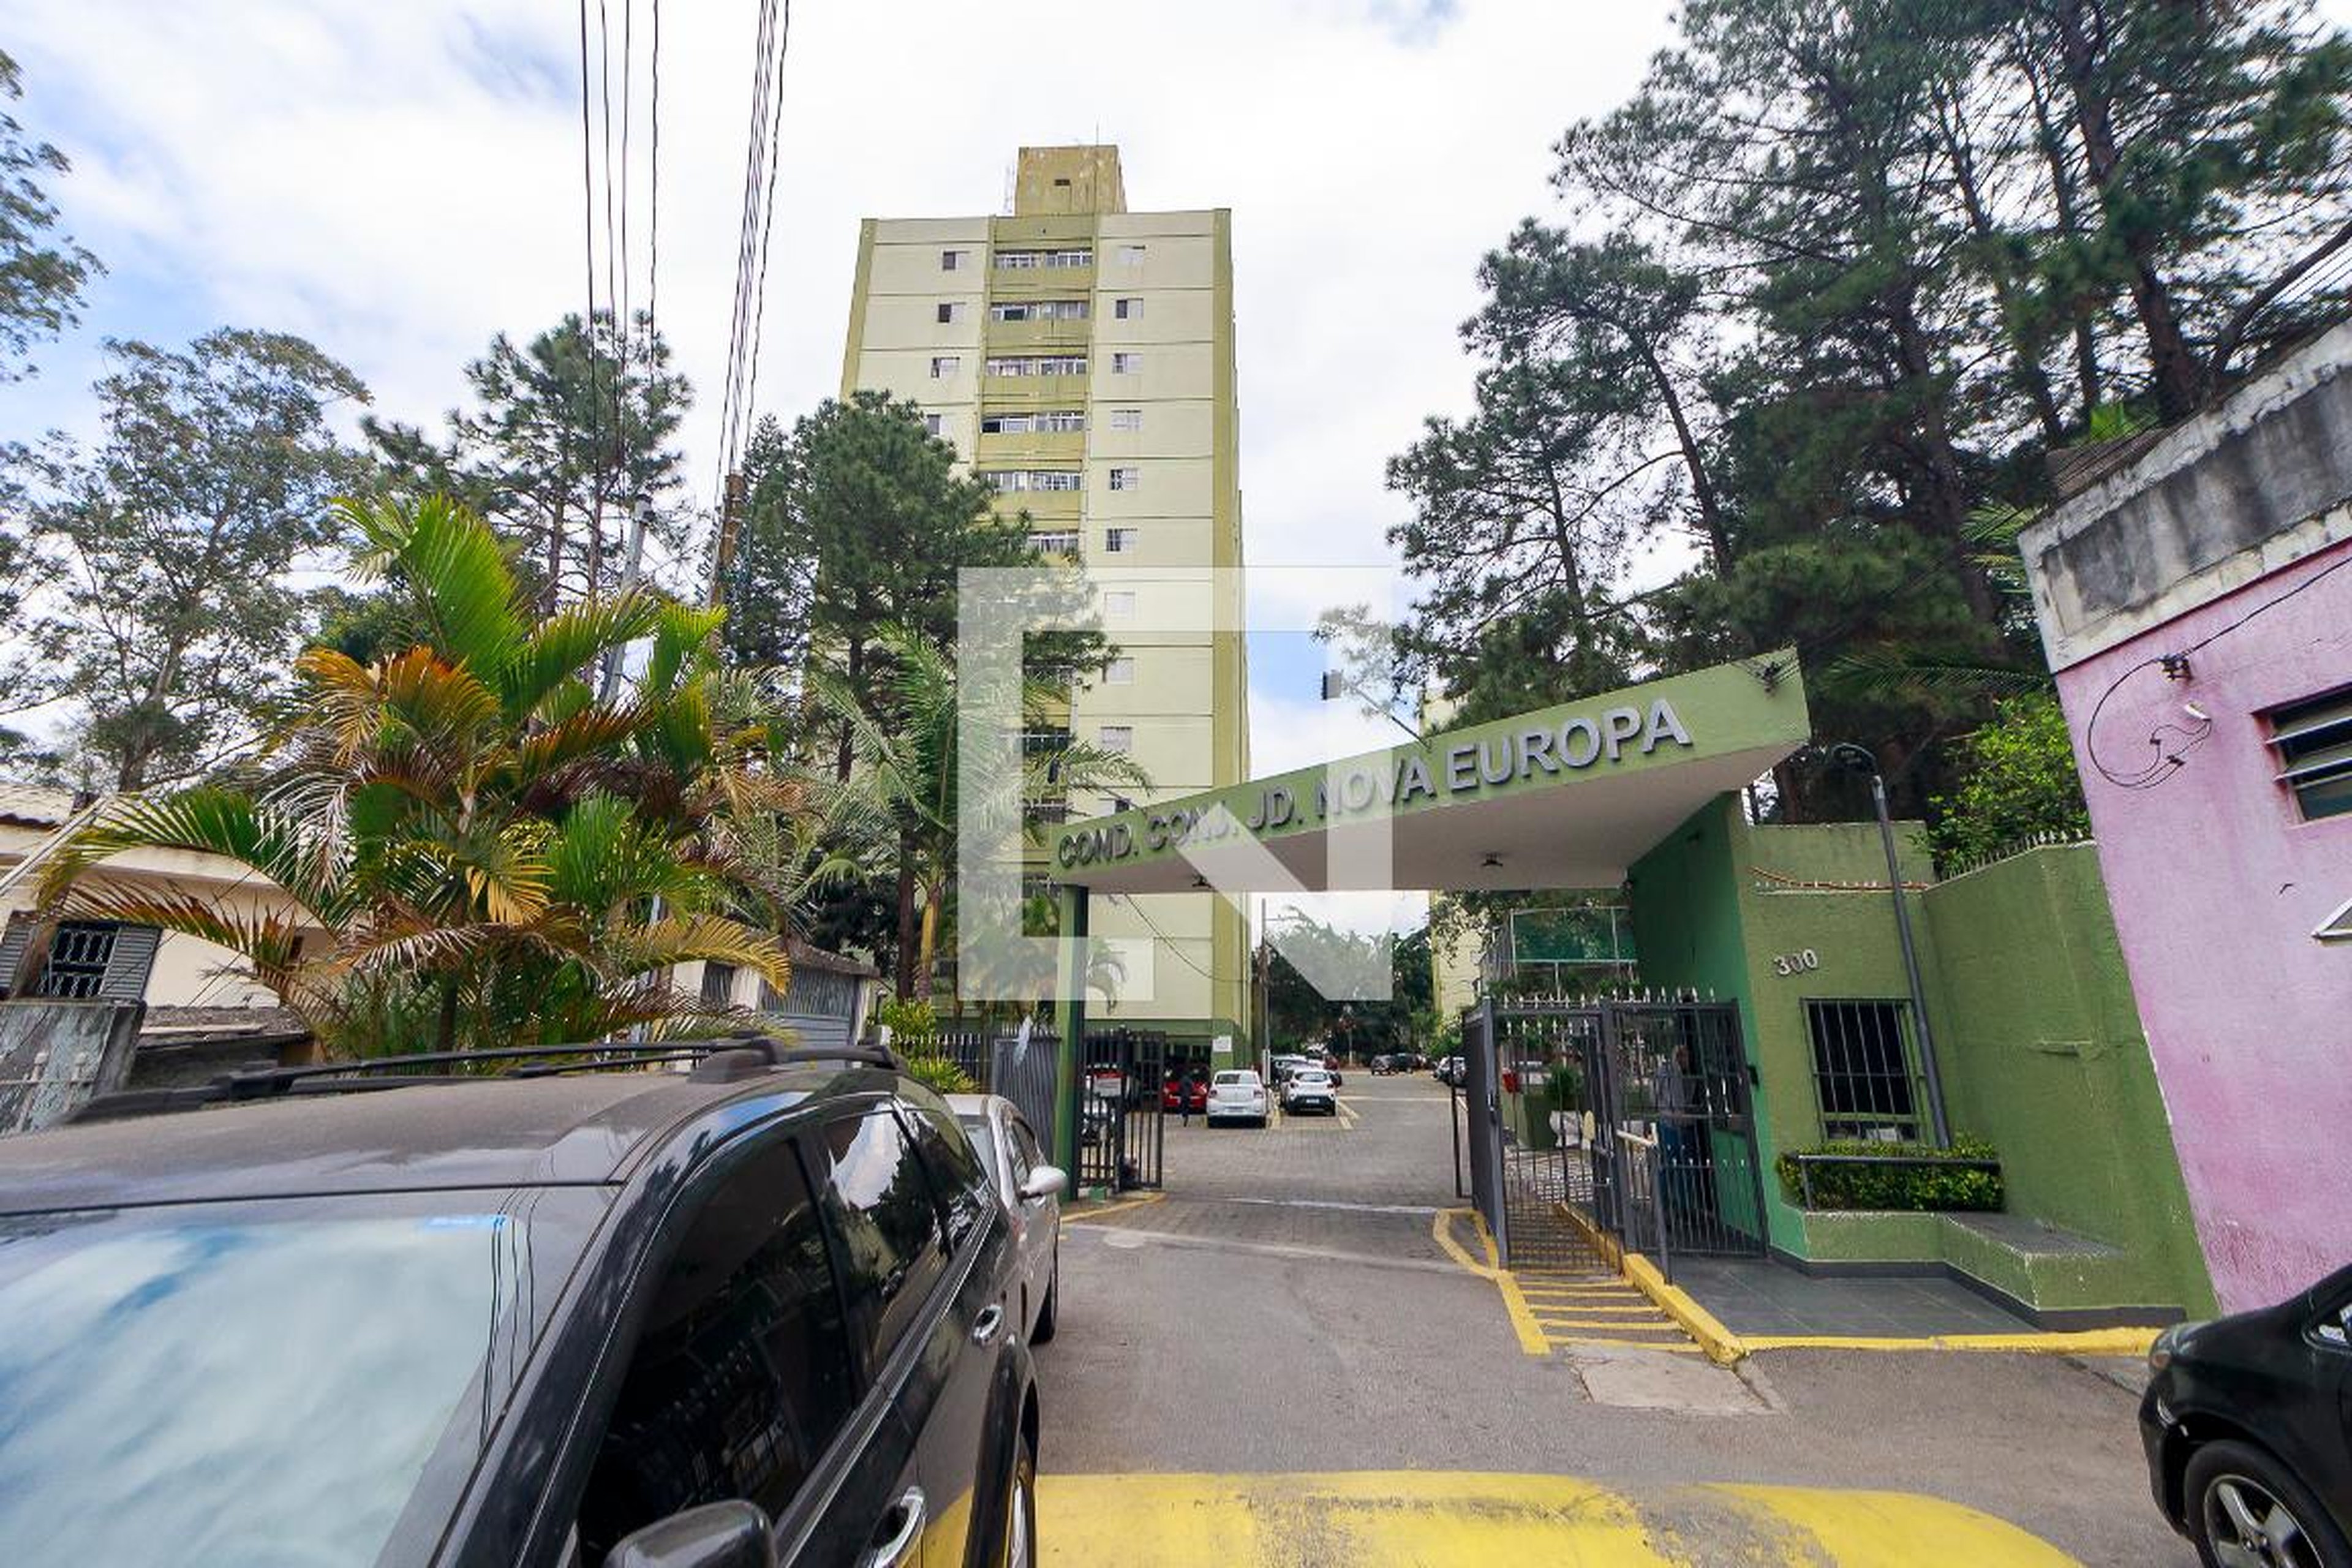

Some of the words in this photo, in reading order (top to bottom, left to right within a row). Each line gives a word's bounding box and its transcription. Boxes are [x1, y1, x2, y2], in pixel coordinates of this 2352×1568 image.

[1059, 823, 1139, 868] COND.
[1247, 783, 1304, 829] JD.
[1314, 755, 1438, 820] NOVA
[1446, 696, 1694, 792] EUROPA
[1774, 949, 1818, 976] 300
